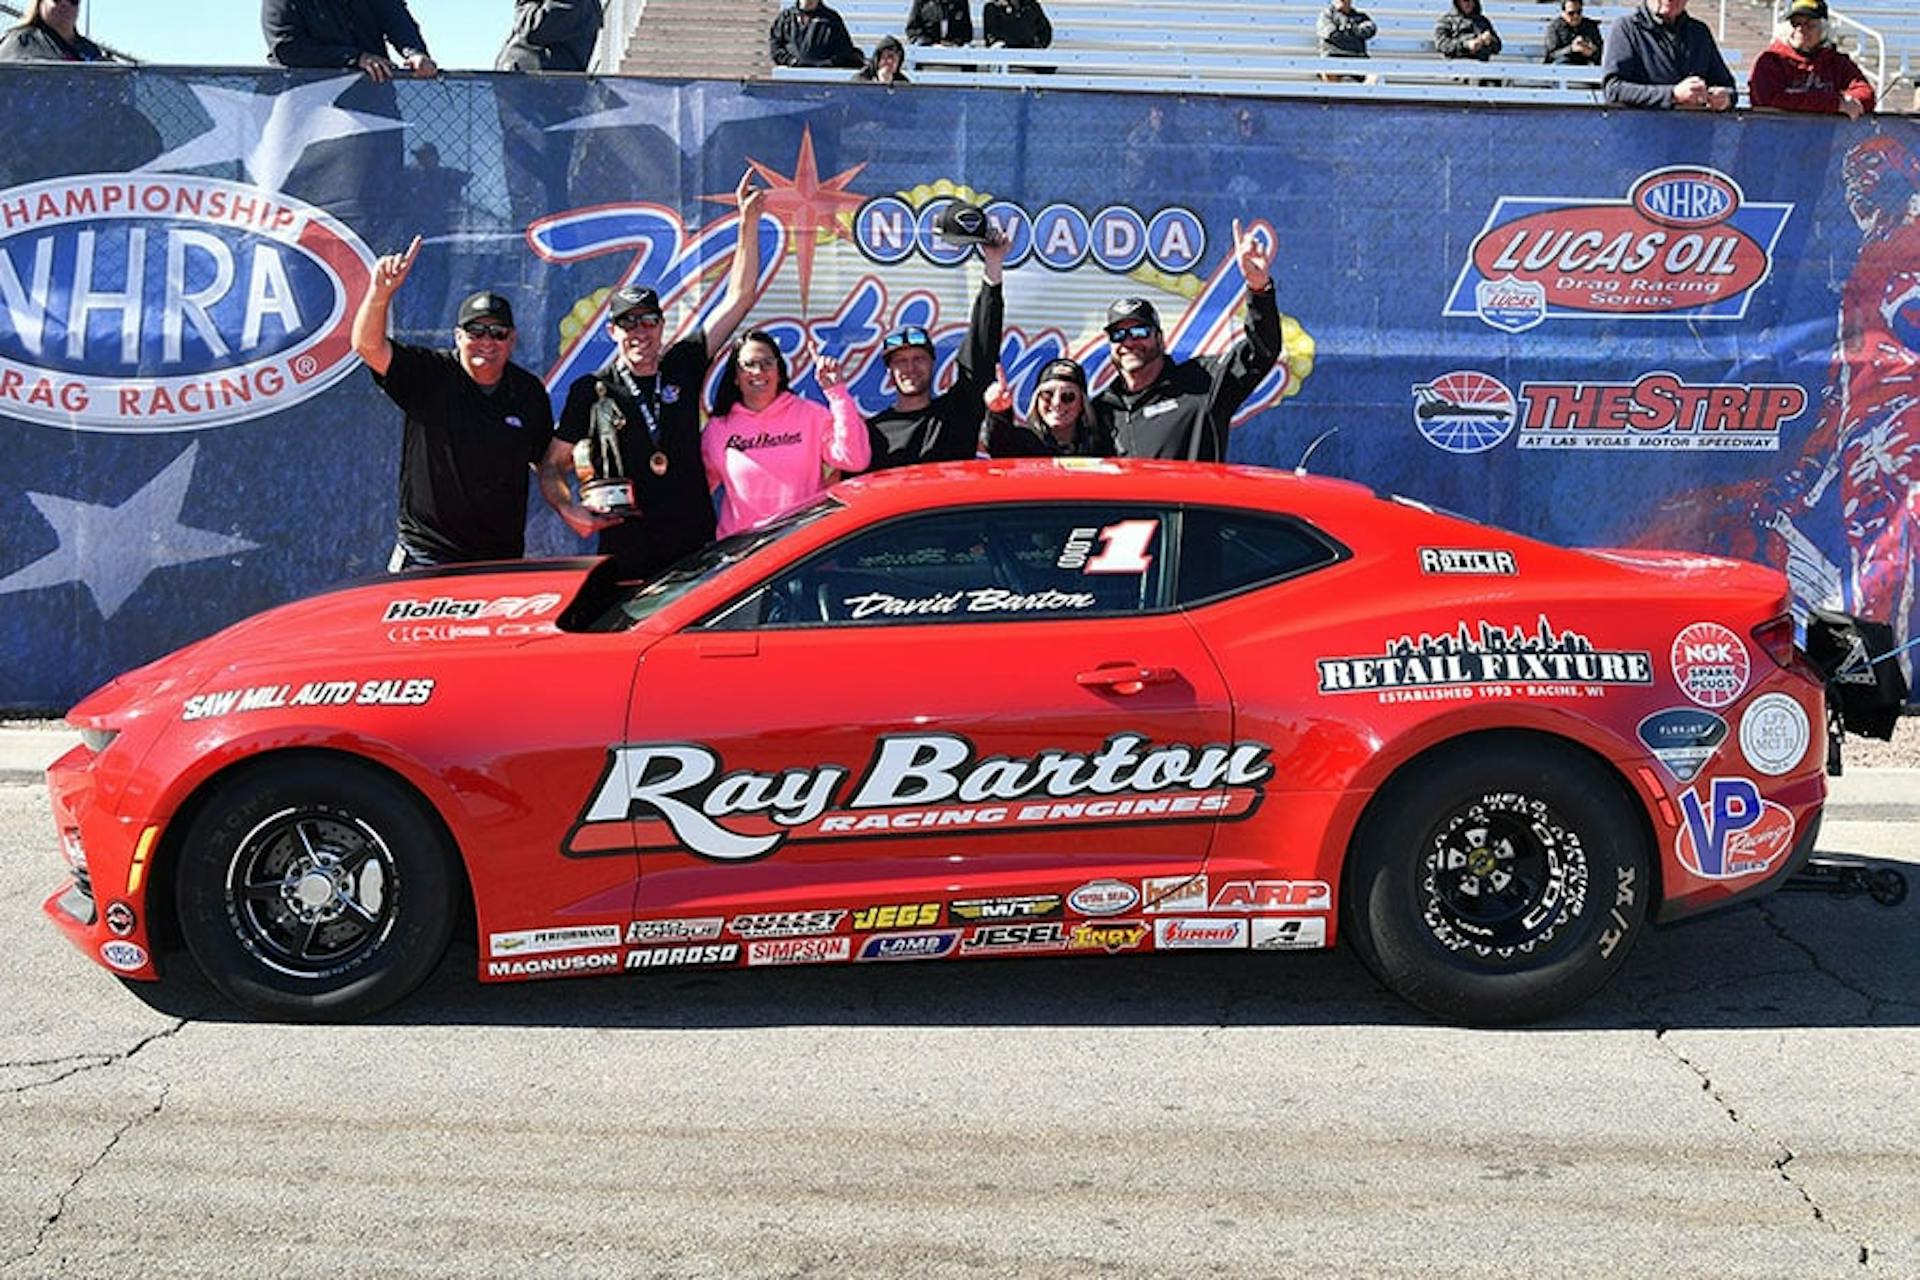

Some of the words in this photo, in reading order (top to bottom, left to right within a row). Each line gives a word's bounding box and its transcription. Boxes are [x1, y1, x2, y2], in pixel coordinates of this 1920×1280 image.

[1651, 182, 1723, 219] NHRA
[1492, 229, 1667, 273] LUCAS
[1663, 232, 1740, 276] OIL
[0, 227, 302, 366] NHRA
[1555, 277, 1620, 293] Drag
[1630, 278, 1722, 295] Racing
[1588, 291, 1674, 305] Series
[118, 365, 285, 416] RACING
[1525, 436, 1543, 448] AT
[1551, 436, 1577, 448] LAS
[1586, 436, 1630, 448] VEGAS
[1639, 436, 1690, 448] MOTOR
[1697, 436, 1773, 448] SPEEDWAY
[1083, 519, 1159, 575] 1
[387, 599, 481, 619] Holley
[843, 592, 964, 619] David
[966, 588, 1096, 612] Barton
[1685, 643, 1733, 662] NGK
[1320, 654, 1473, 690] RETAIL
[1480, 652, 1650, 683] FIXTURE
[1690, 667, 1733, 677] SPARK
[1379, 687, 1473, 704] ESTABLISHED
[1691, 679, 1733, 689] PLUGS
[182, 690, 241, 720] SAW
[236, 685, 291, 711] MILL
[289, 681, 357, 706] AUTO
[356, 679, 435, 705] SALES
[584, 748, 849, 859] Ray
[850, 734, 1270, 808] Barton
[818, 808, 1008, 833] RACING
[1017, 795, 1233, 820] ENGINES
[1679, 780, 1760, 876] VP
[1217, 884, 1327, 906] ARP
[852, 903, 941, 930] JEGS
[982, 901, 1036, 917] M/T
[964, 924, 1068, 947] JESEL
[624, 944, 740, 968] MOROSO
[753, 938, 842, 958] SIMPSON
[488, 953, 618, 976] MAGNUSON
